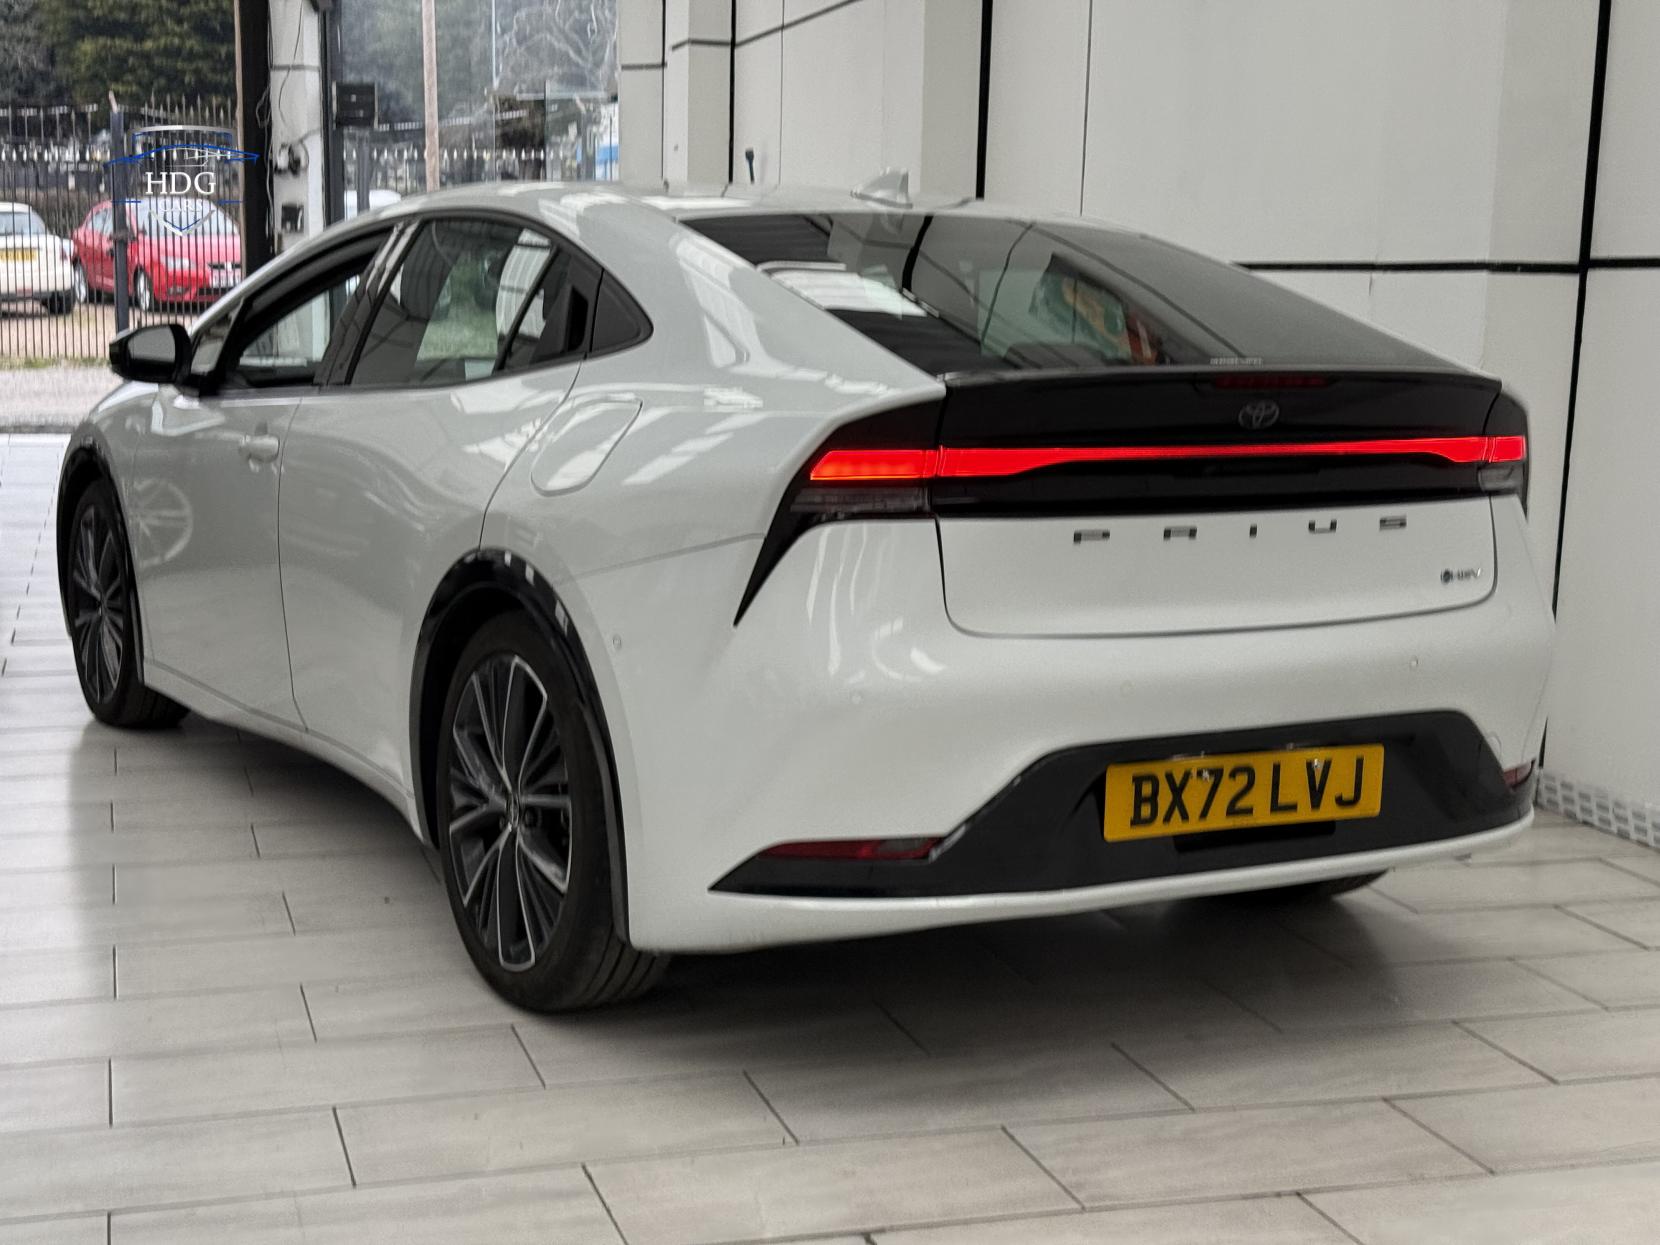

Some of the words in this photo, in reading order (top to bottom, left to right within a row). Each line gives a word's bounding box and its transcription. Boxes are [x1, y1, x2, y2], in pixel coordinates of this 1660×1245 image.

[1073, 516, 1407, 543] PRIUS
[1130, 763, 1257, 828] BX72
[1269, 756, 1364, 812] LVJ
